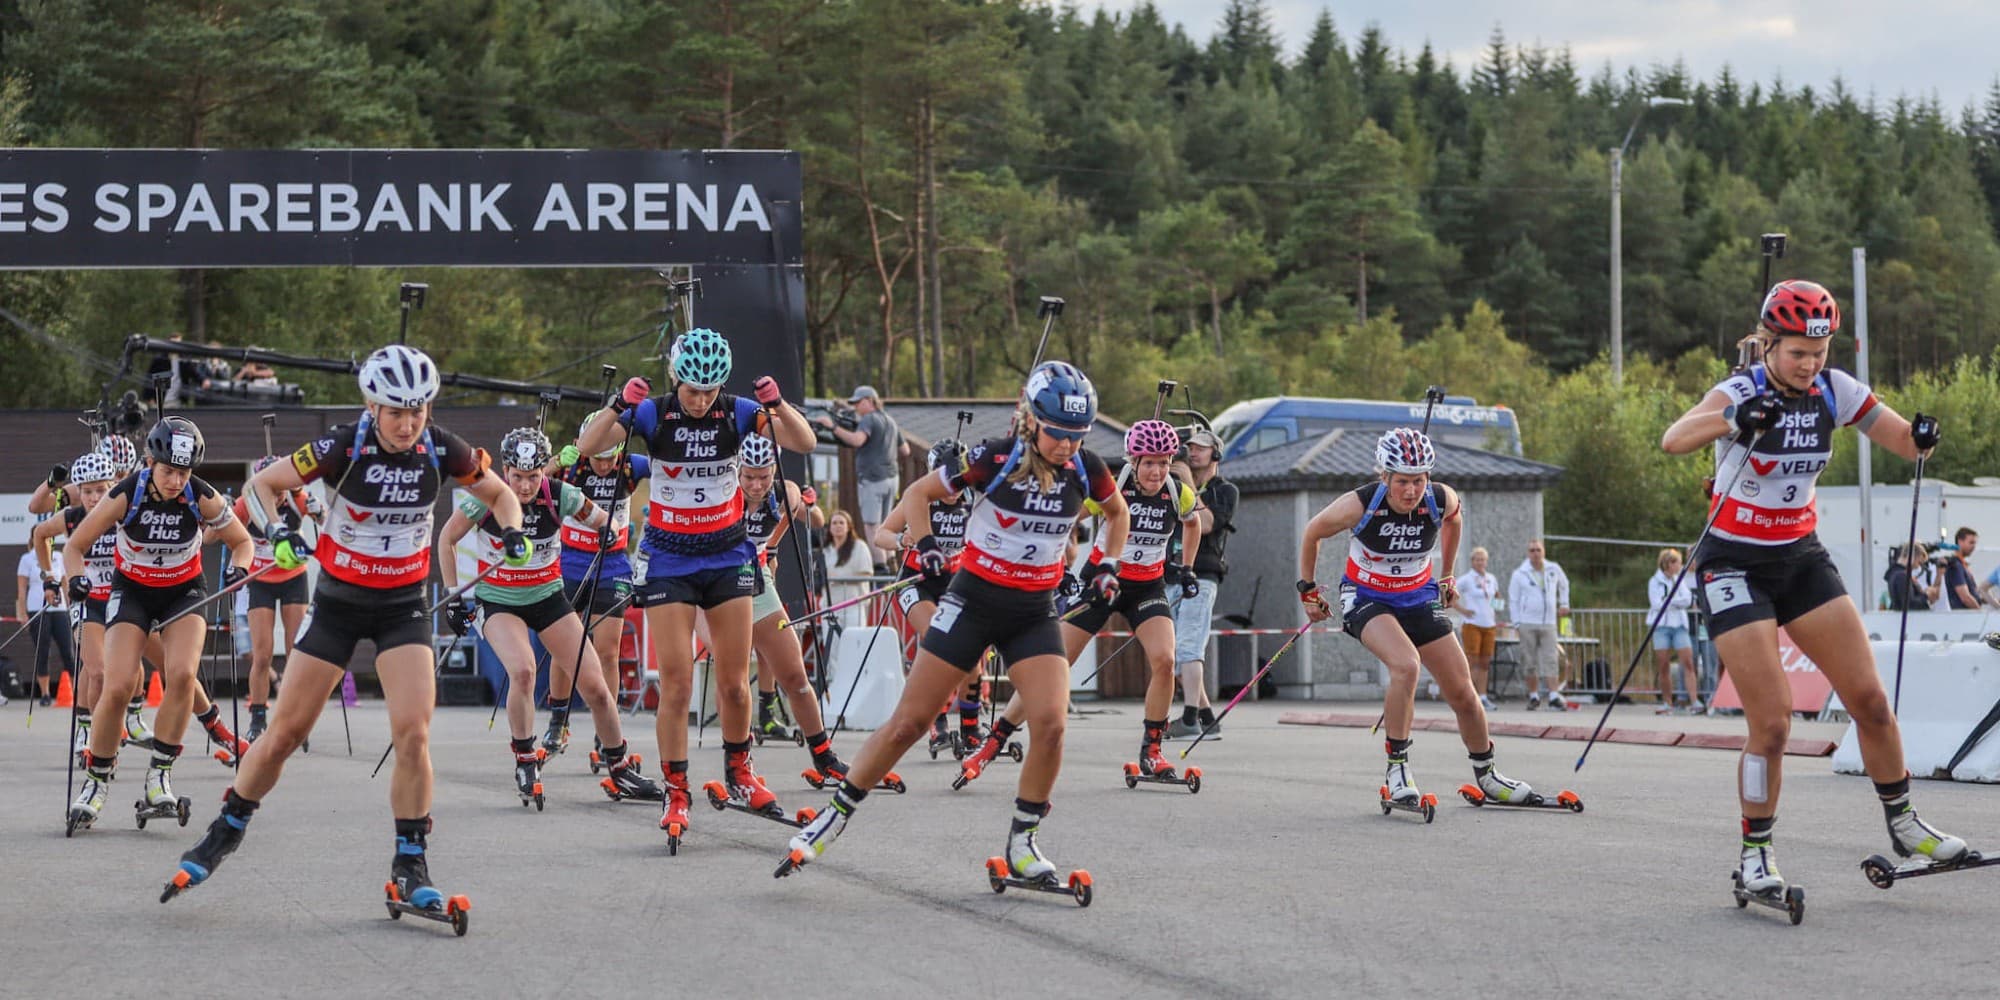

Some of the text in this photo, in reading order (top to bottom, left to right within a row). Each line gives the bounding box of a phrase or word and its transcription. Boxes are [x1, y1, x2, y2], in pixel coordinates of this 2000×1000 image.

[93, 183, 513, 232] SPAREBANK
[533, 183, 772, 232] ARENA
[674, 427, 719, 442] Øster
[1783, 430, 1819, 448] Hus
[685, 444, 717, 458] Hus
[365, 464, 424, 484] Øster
[1781, 460, 1827, 475] VELD
[585, 475, 617, 487] Øste
[378, 484, 420, 502] Hus
[694, 488, 705, 503] 5
[1782, 485, 1798, 503] 3
[1023, 493, 1063, 513] Hus
[1130, 502, 1167, 518] Øster
[140, 510, 183, 525] Øster
[932, 511, 964, 523] Øster
[1136, 516, 1164, 530] Hus
[148, 526, 180, 540] Hus
[940, 524, 964, 534] Hus
[1379, 521, 1424, 536] Øster
[1389, 537, 1422, 550] Hus
[1022, 544, 1037, 560] 2
[1132, 550, 1143, 561] 9
[152, 556, 164, 567] 4
[98, 570, 112, 584] 10
[1720, 587, 1735, 602] 3
